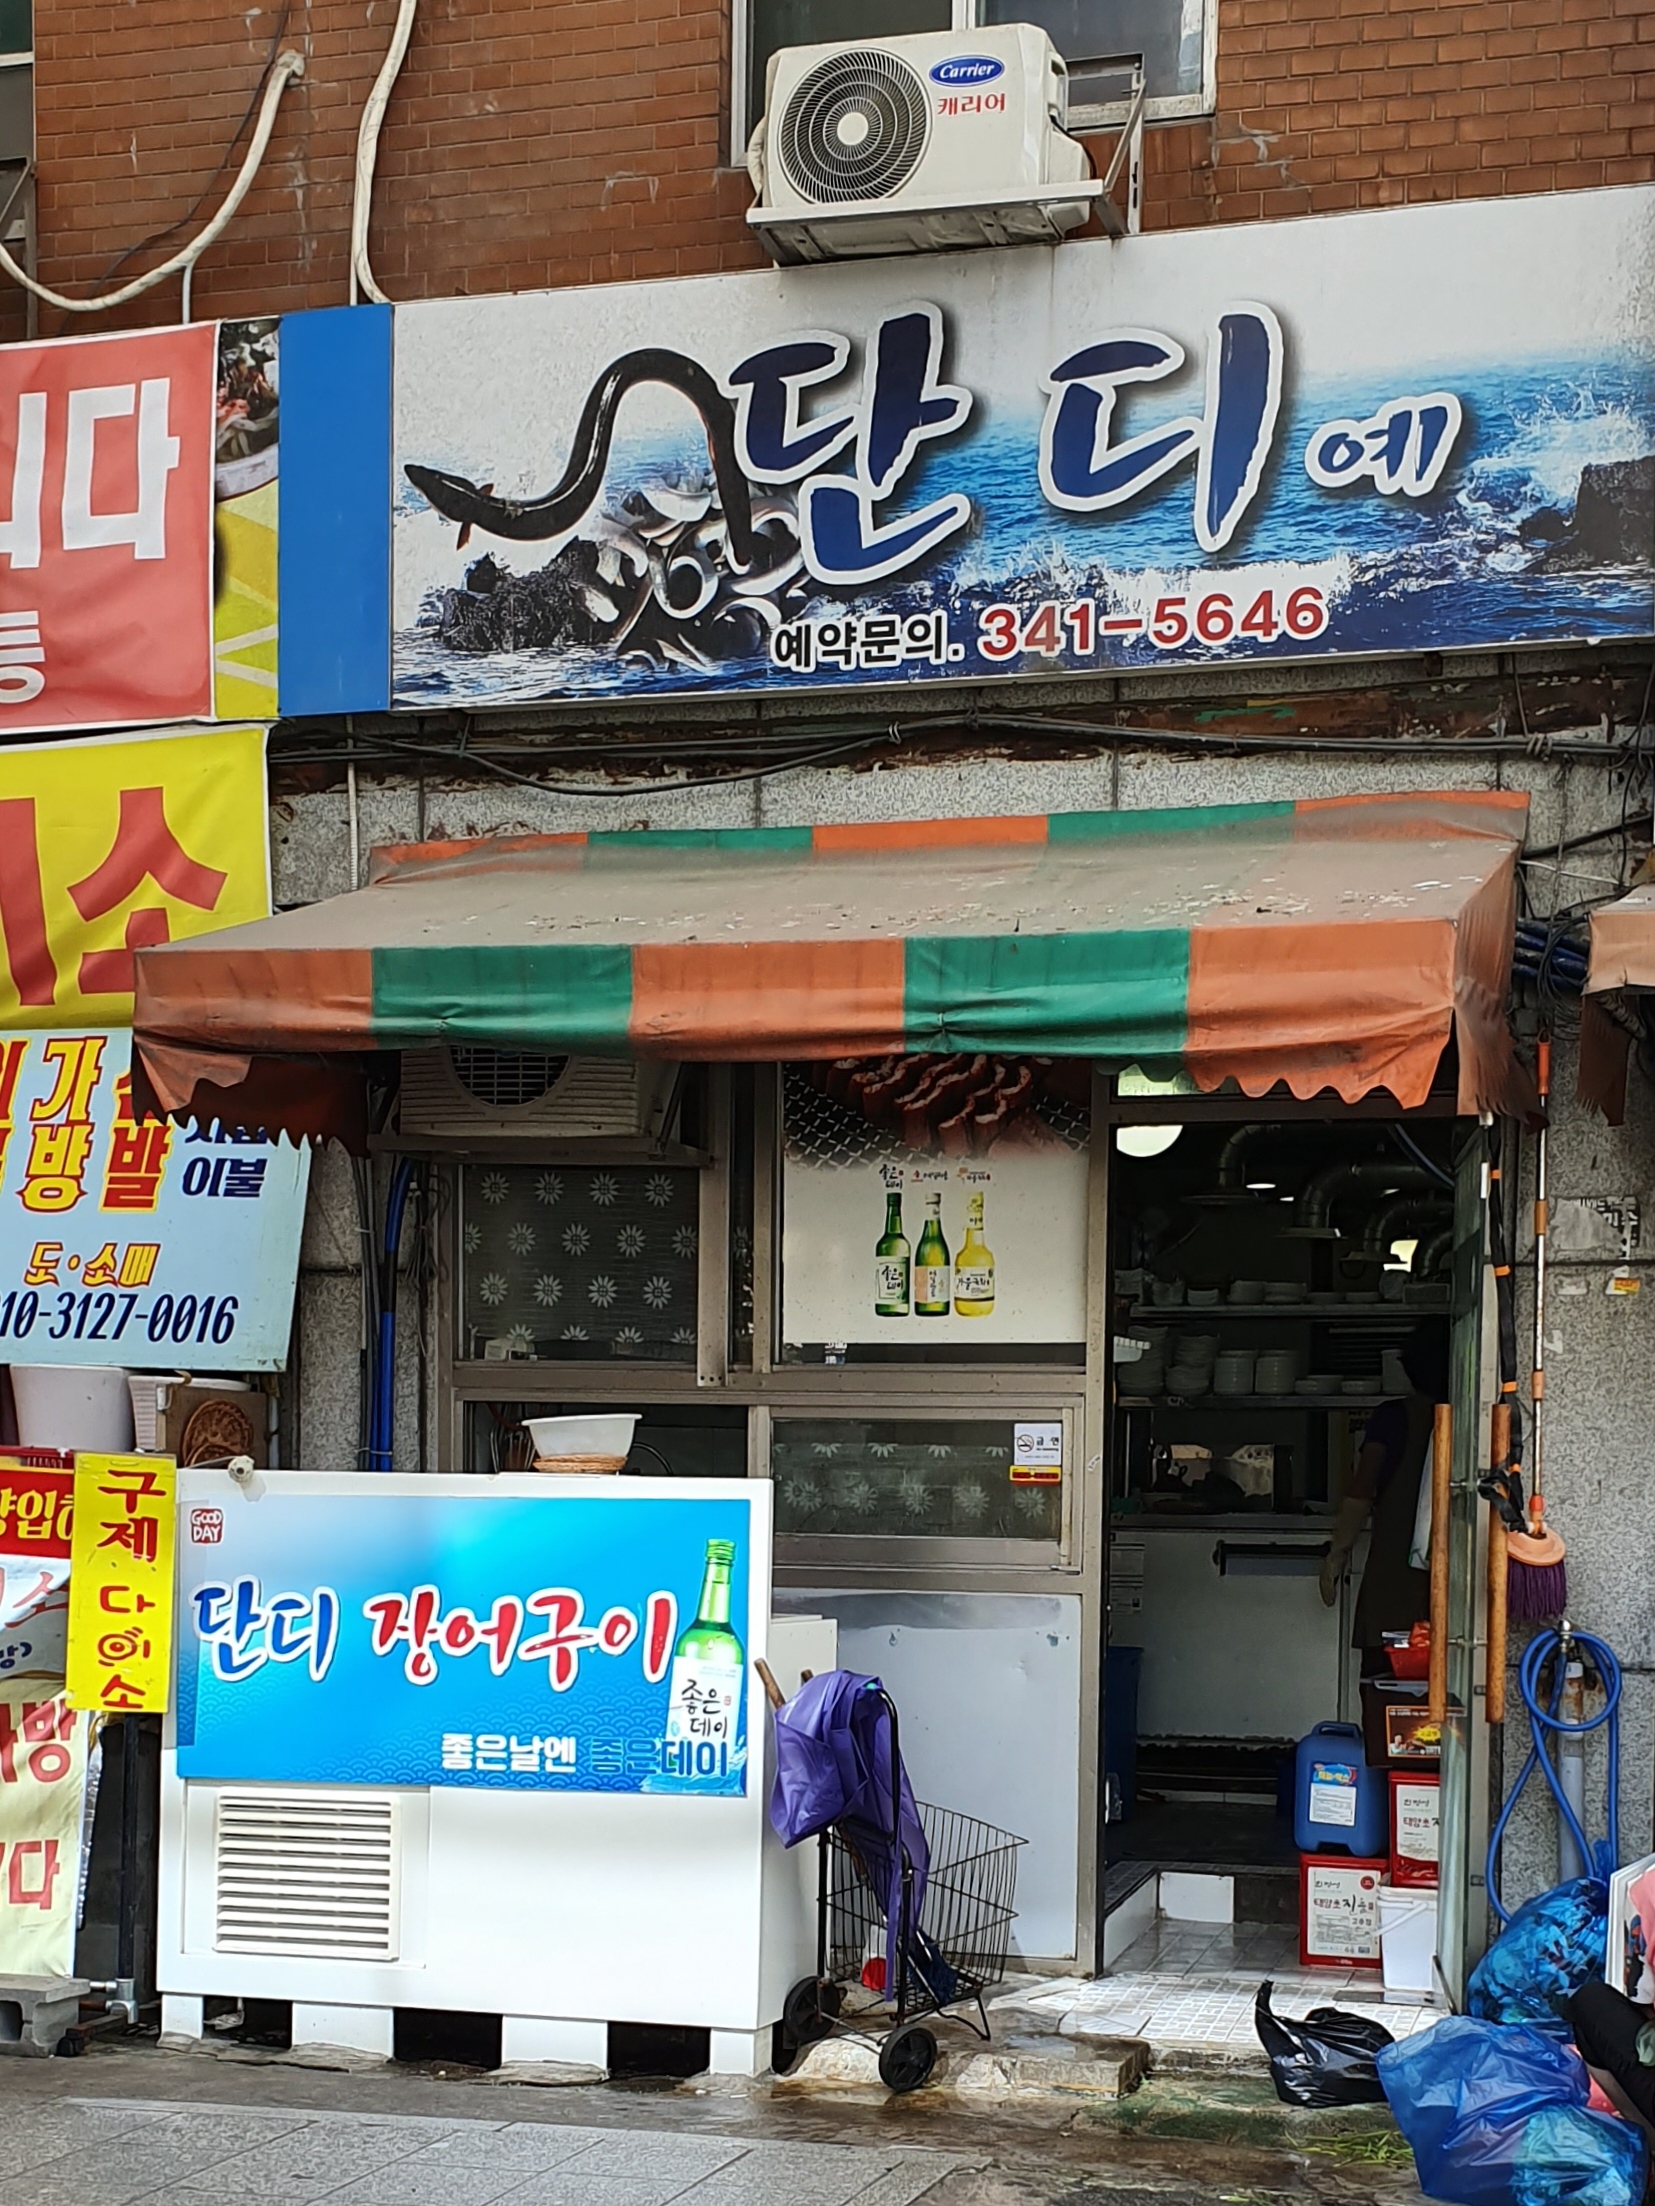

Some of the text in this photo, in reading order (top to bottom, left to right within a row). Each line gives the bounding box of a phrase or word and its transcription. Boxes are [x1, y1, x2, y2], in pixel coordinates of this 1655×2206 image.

[940, 63, 995, 79] Carrier
[938, 93, 1006, 116] 캐리어
[774, 586, 1325, 668] 예약문의. 341-5646
[182, 1157, 267, 1198] 이불
[192, 1510, 222, 1526] GOOD
[193, 1525, 221, 1542] DAY
[191, 1578, 676, 1688] 단디 장어구이
[682, 1679, 721, 1715] 좋은
[690, 1716, 727, 1739] 데이
[442, 1733, 727, 1777] 좋은날엔 좋은데이
[0, 1839, 60, 1910] 다
